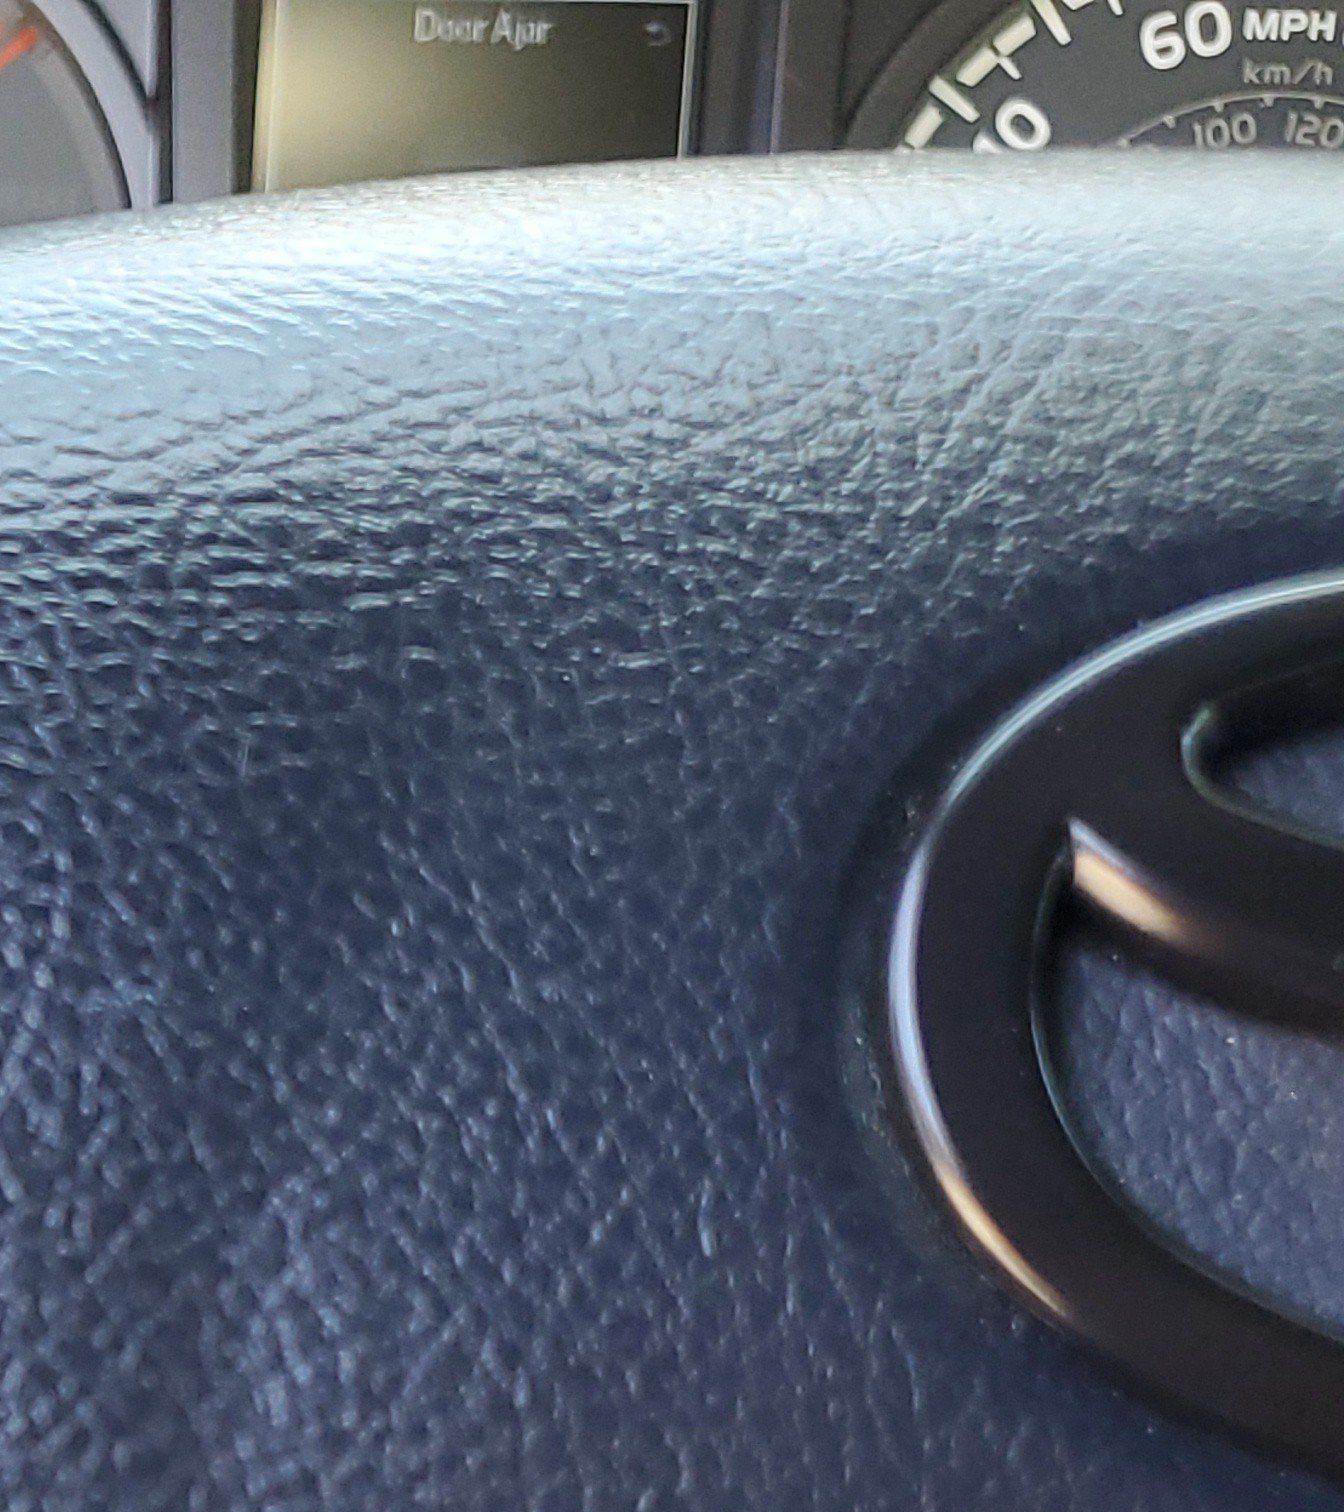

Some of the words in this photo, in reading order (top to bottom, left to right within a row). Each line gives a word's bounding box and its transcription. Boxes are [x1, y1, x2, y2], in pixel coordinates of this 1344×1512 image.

[1139, 0, 1233, 70] 60
[1242, 6, 1338, 42] MPH
[1242, 57, 1334, 86] km/h
[1193, 112, 1257, 149] 100
[1284, 108, 1344, 149] 120
